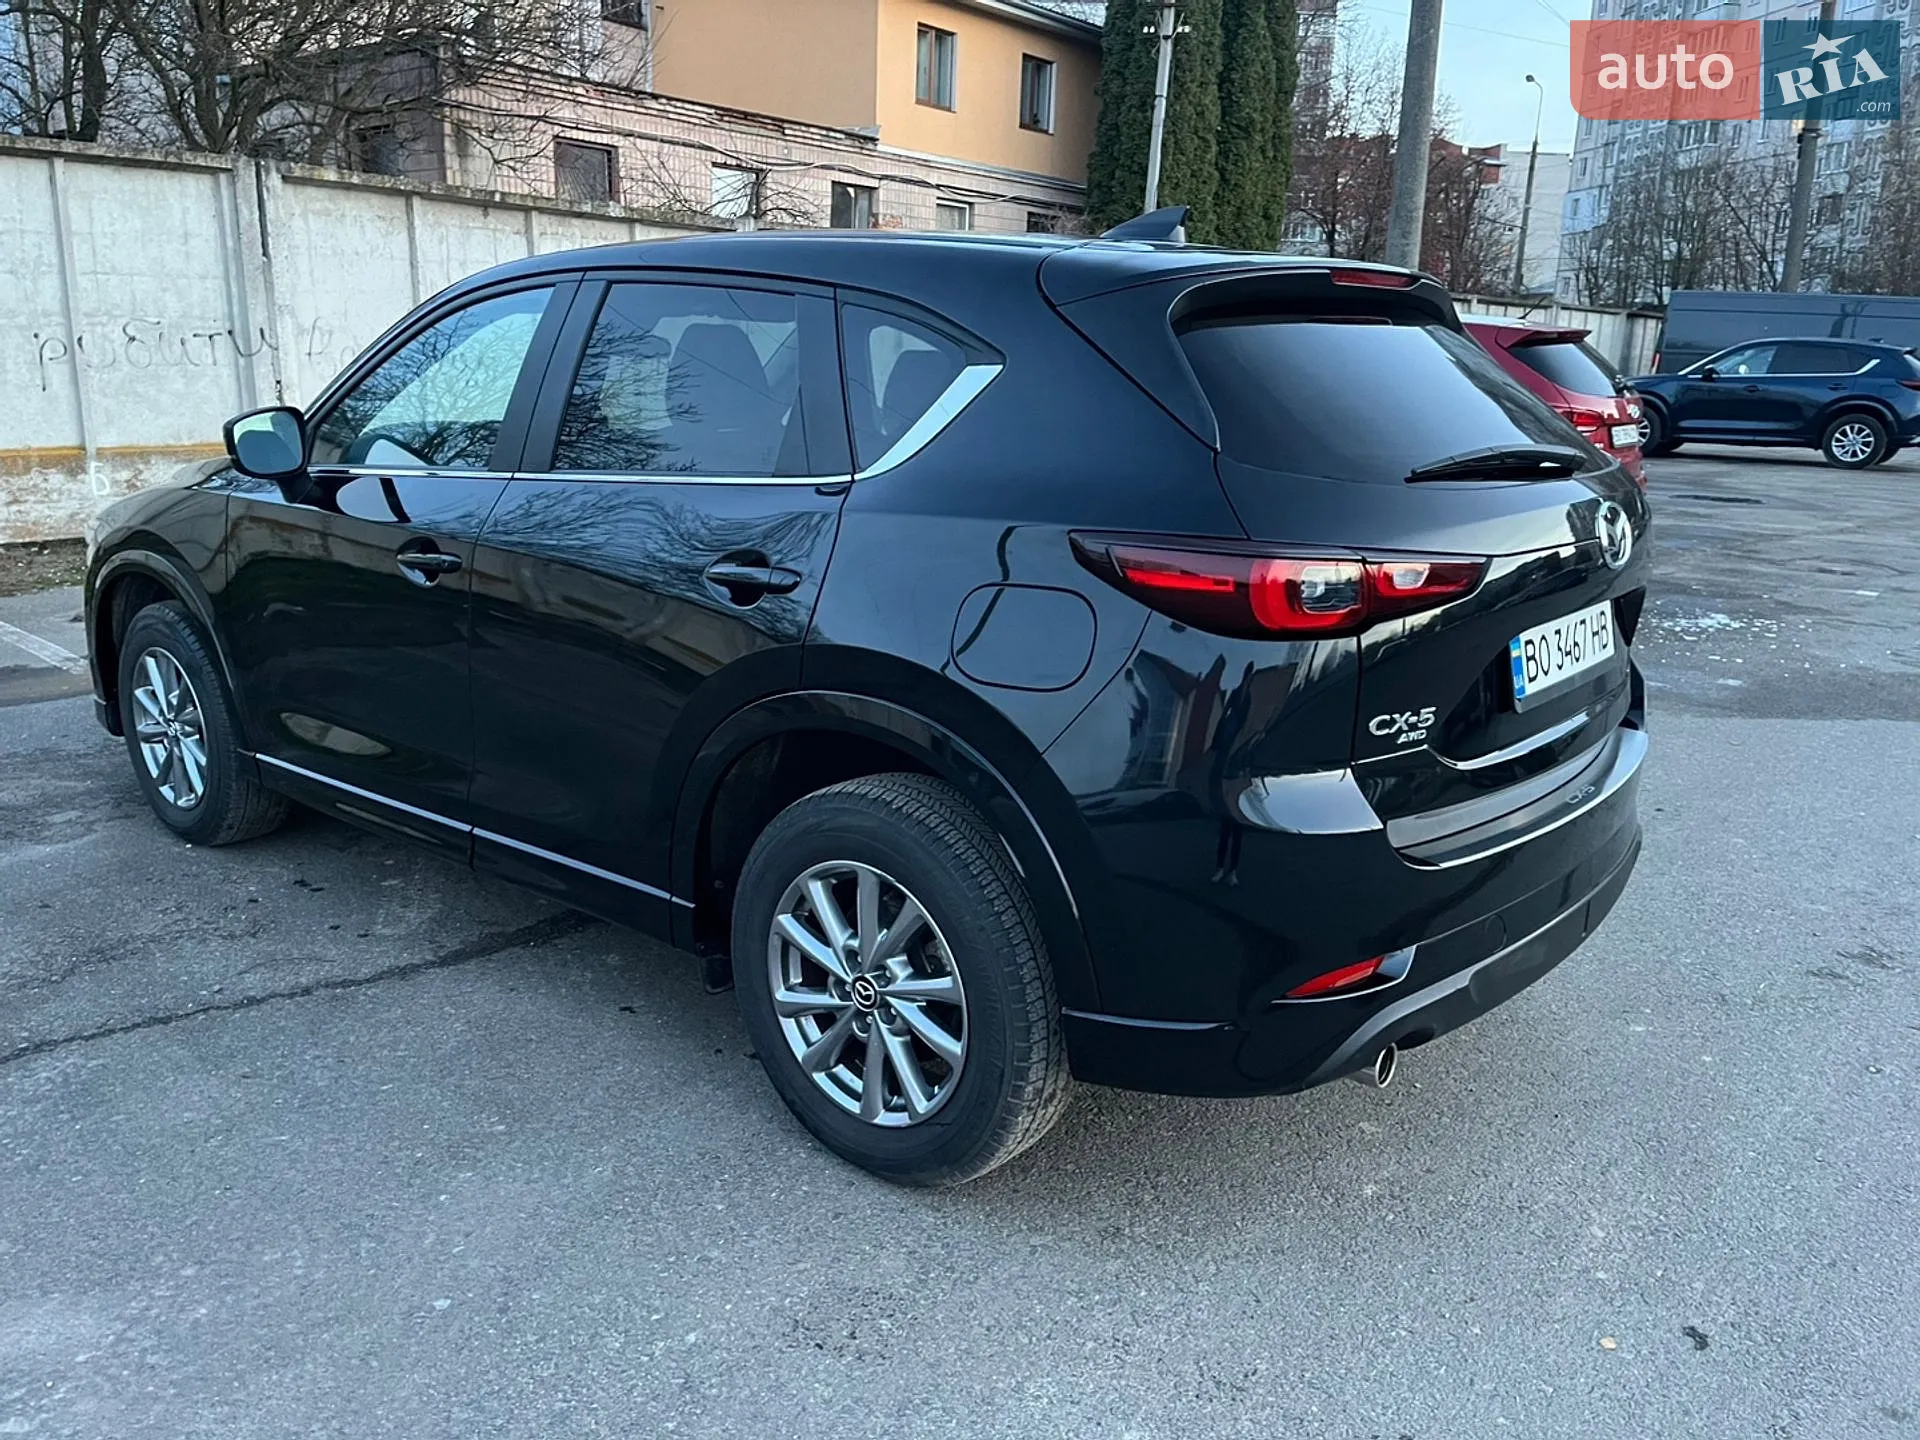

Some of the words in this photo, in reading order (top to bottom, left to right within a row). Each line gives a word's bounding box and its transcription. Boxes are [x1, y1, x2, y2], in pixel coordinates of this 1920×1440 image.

[1554, 617, 1588, 671] 3467
[1368, 706, 1437, 736] CX-5
[1396, 729, 1427, 744] AWD
